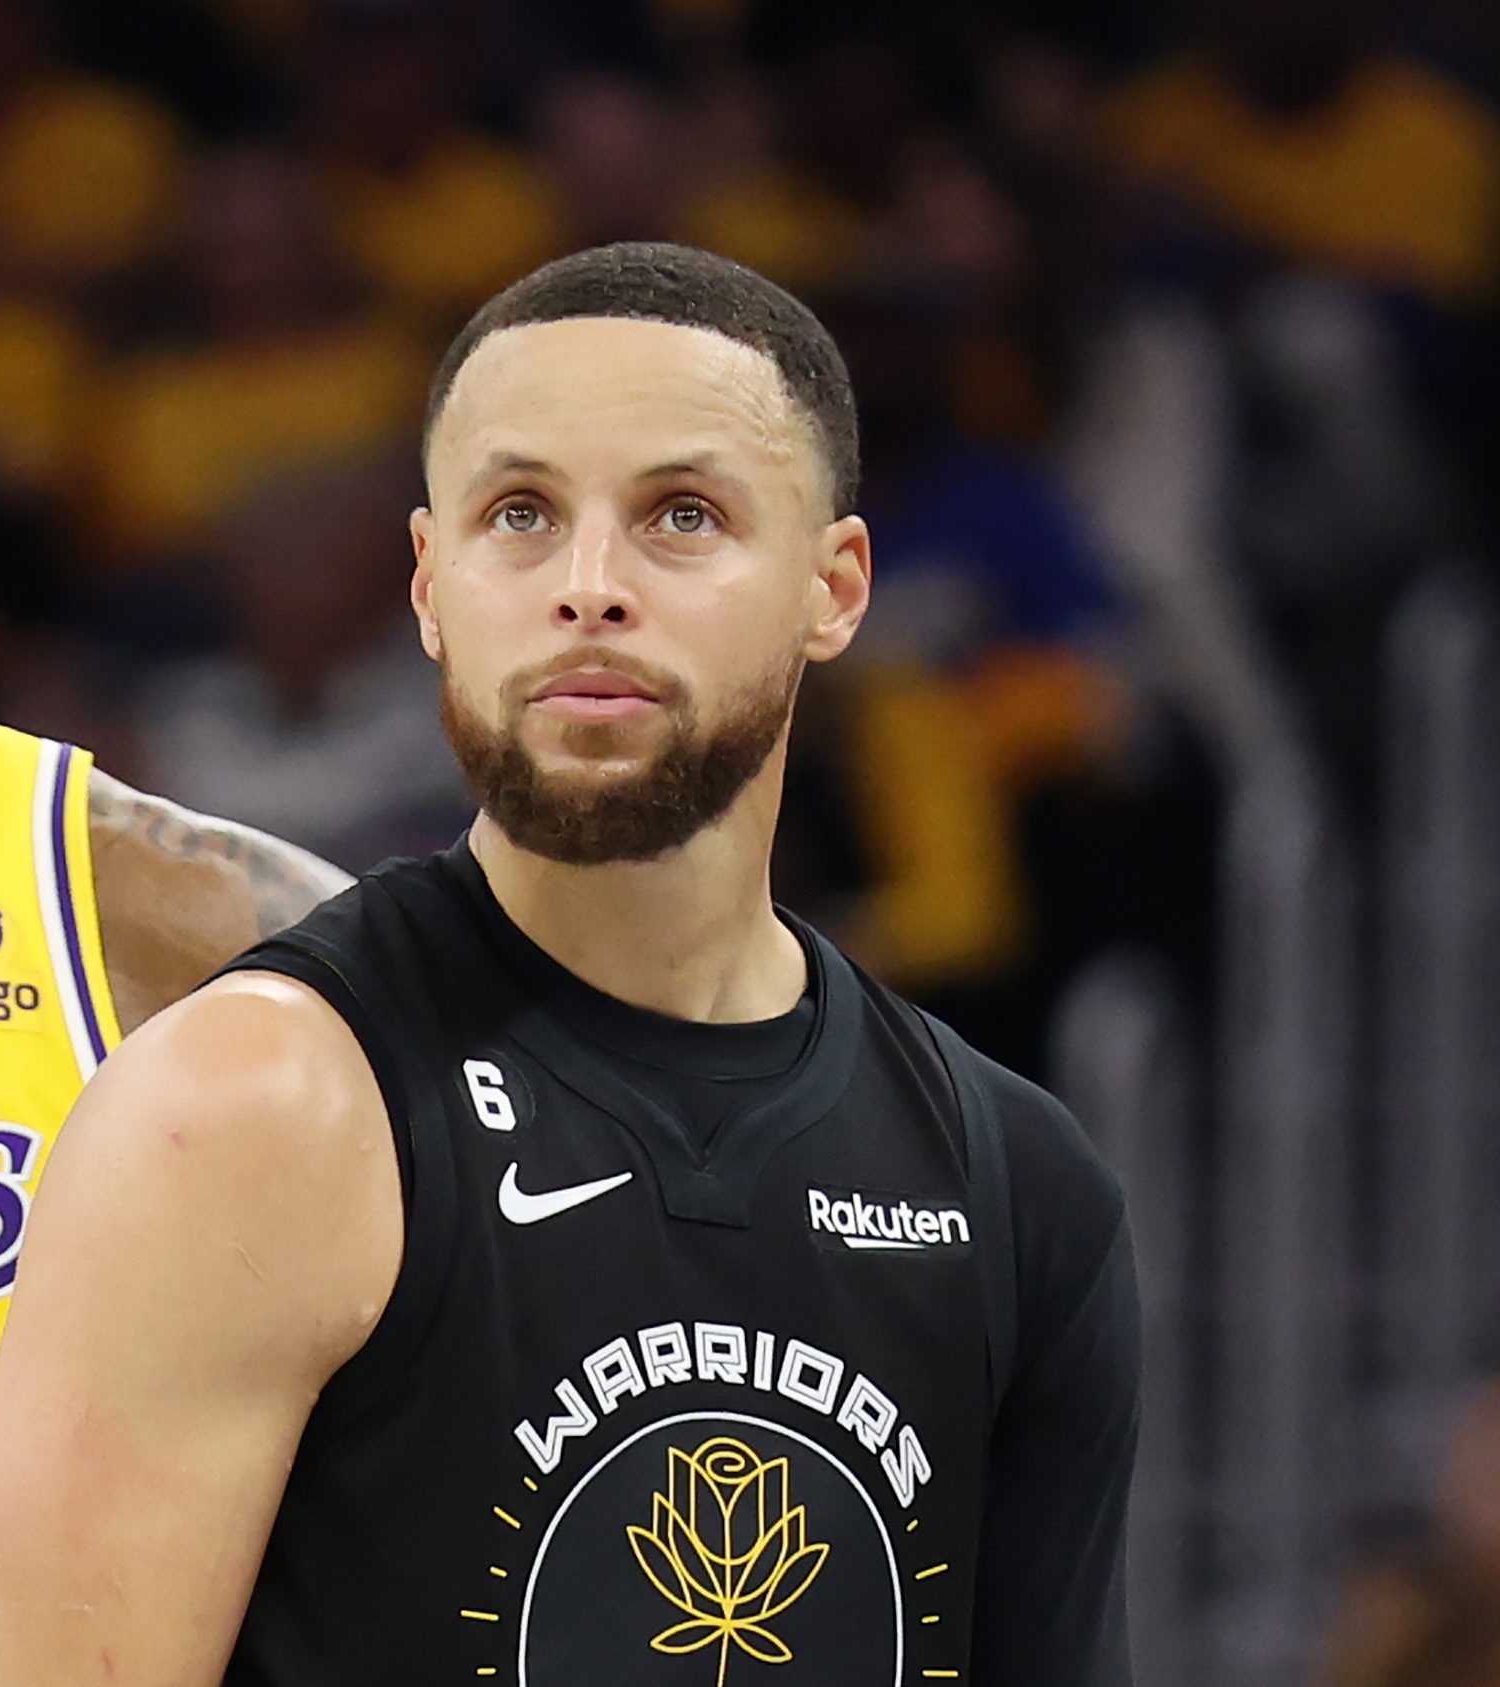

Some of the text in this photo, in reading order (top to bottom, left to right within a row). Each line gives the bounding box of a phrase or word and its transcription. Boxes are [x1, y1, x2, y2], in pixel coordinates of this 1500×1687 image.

[462, 1058, 517, 1131] 6
[808, 1188, 970, 1246] Rakuten
[513, 1321, 932, 1508] WARRIORS
